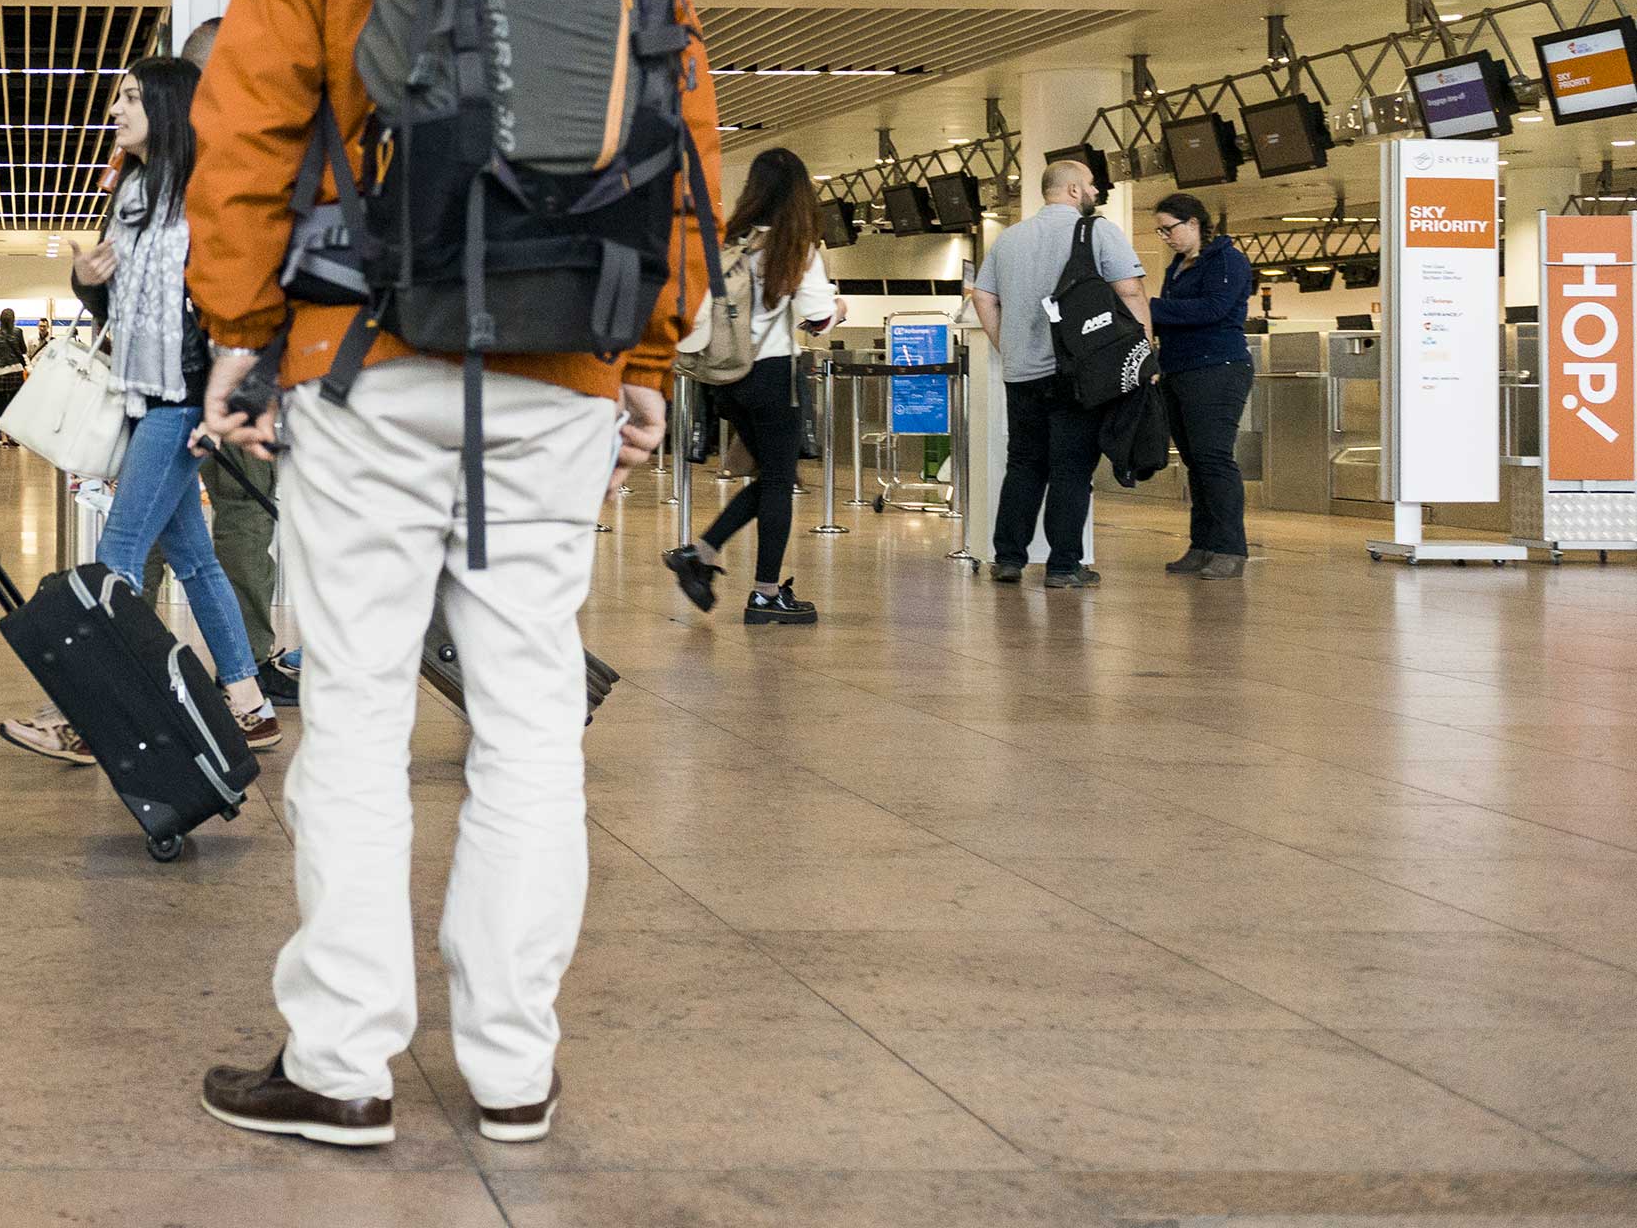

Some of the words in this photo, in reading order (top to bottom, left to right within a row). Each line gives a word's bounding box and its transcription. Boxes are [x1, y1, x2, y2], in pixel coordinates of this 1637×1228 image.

[1556, 71, 1572, 83] SKY
[1437, 155, 1490, 164] SKYTEAM
[1409, 205, 1447, 218] SKY
[1409, 219, 1489, 233] PRIORITY
[1561, 252, 1620, 444] HOP!
